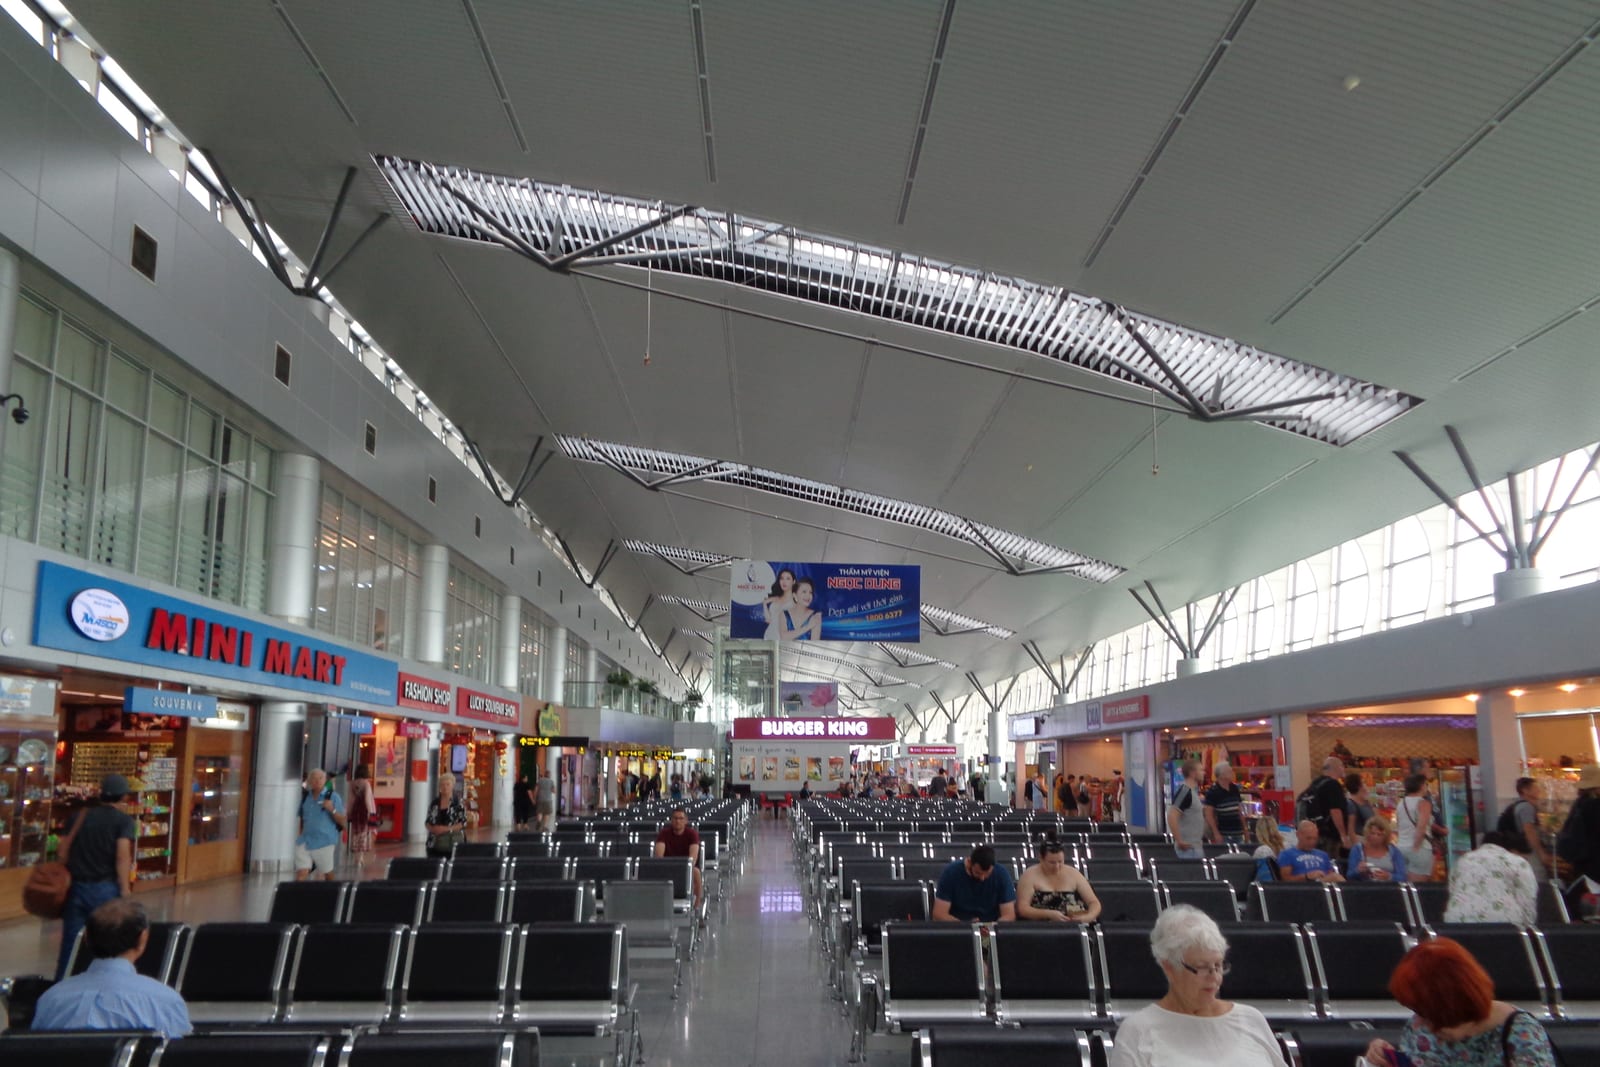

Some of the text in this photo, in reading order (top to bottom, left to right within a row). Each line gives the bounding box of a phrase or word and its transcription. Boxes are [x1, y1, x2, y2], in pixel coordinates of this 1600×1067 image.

[827, 577, 901, 590] NGỌC DUNG
[147, 608, 346, 686] MINI MART
[153, 696, 203, 712] SOUVENIR
[404, 681, 434, 703] FASHION
[434, 688, 451, 707] SHOP
[469, 694, 516, 718] LUCKY SOUVENIR SHOP
[761, 721, 868, 736] BURGER KING
